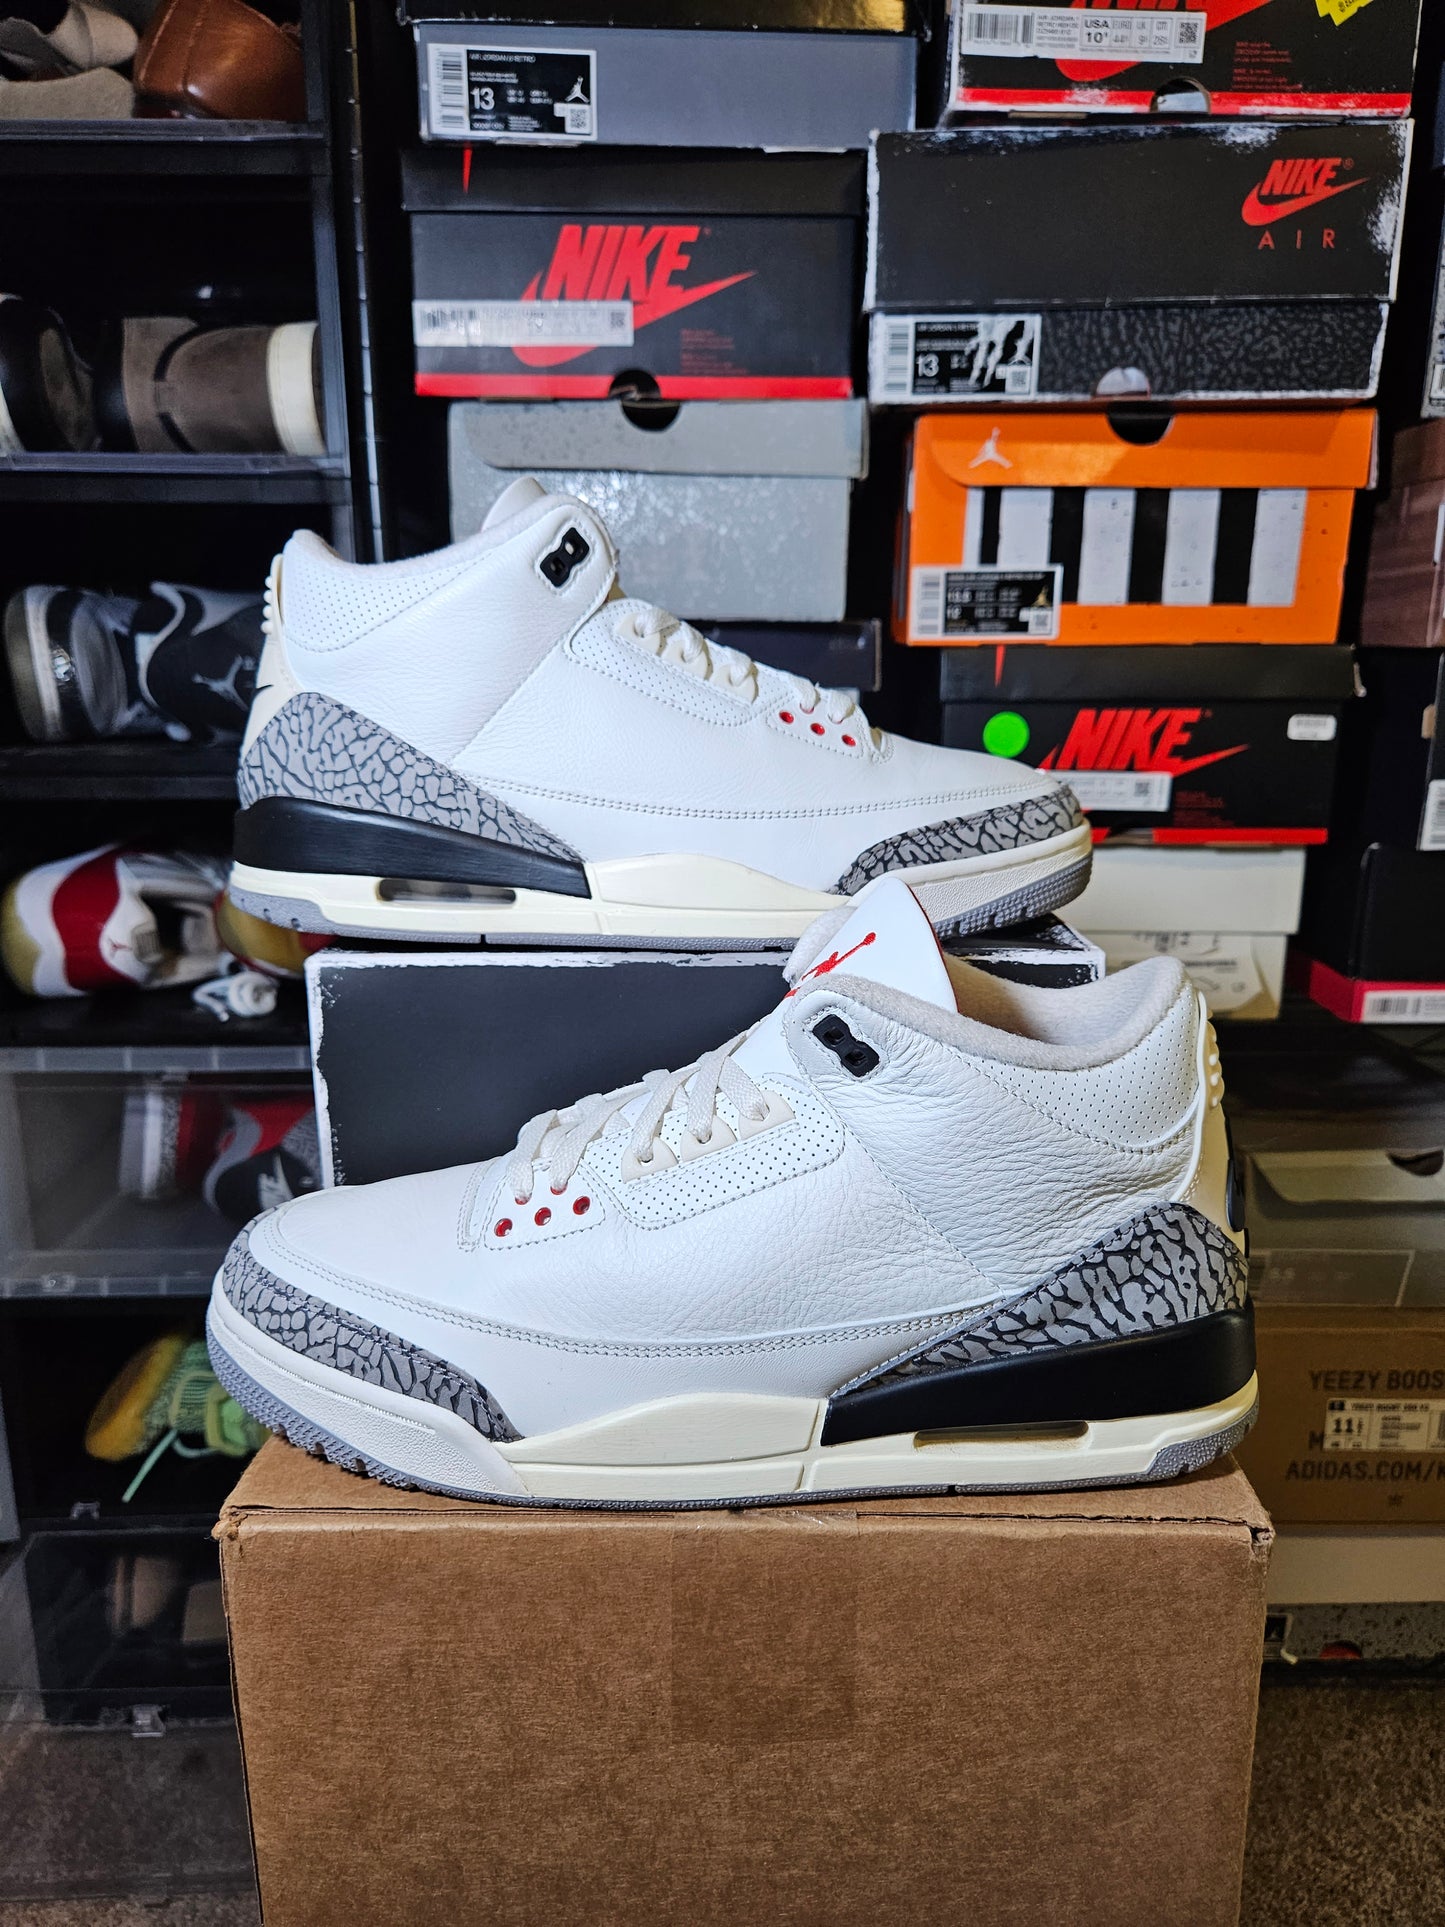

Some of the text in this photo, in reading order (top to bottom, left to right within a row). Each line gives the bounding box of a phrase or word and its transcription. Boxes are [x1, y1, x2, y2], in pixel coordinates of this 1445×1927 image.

[1084, 19, 1110, 29] USA
[470, 87, 495, 110] 13
[1259, 158, 1342, 195] NIKE
[1258, 228, 1336, 249] AIR
[542, 224, 701, 301] NIKE
[916, 352, 939, 377] 13
[1055, 708, 1201, 770] NIKE
[1309, 1369, 1381, 1391] YEEZY
